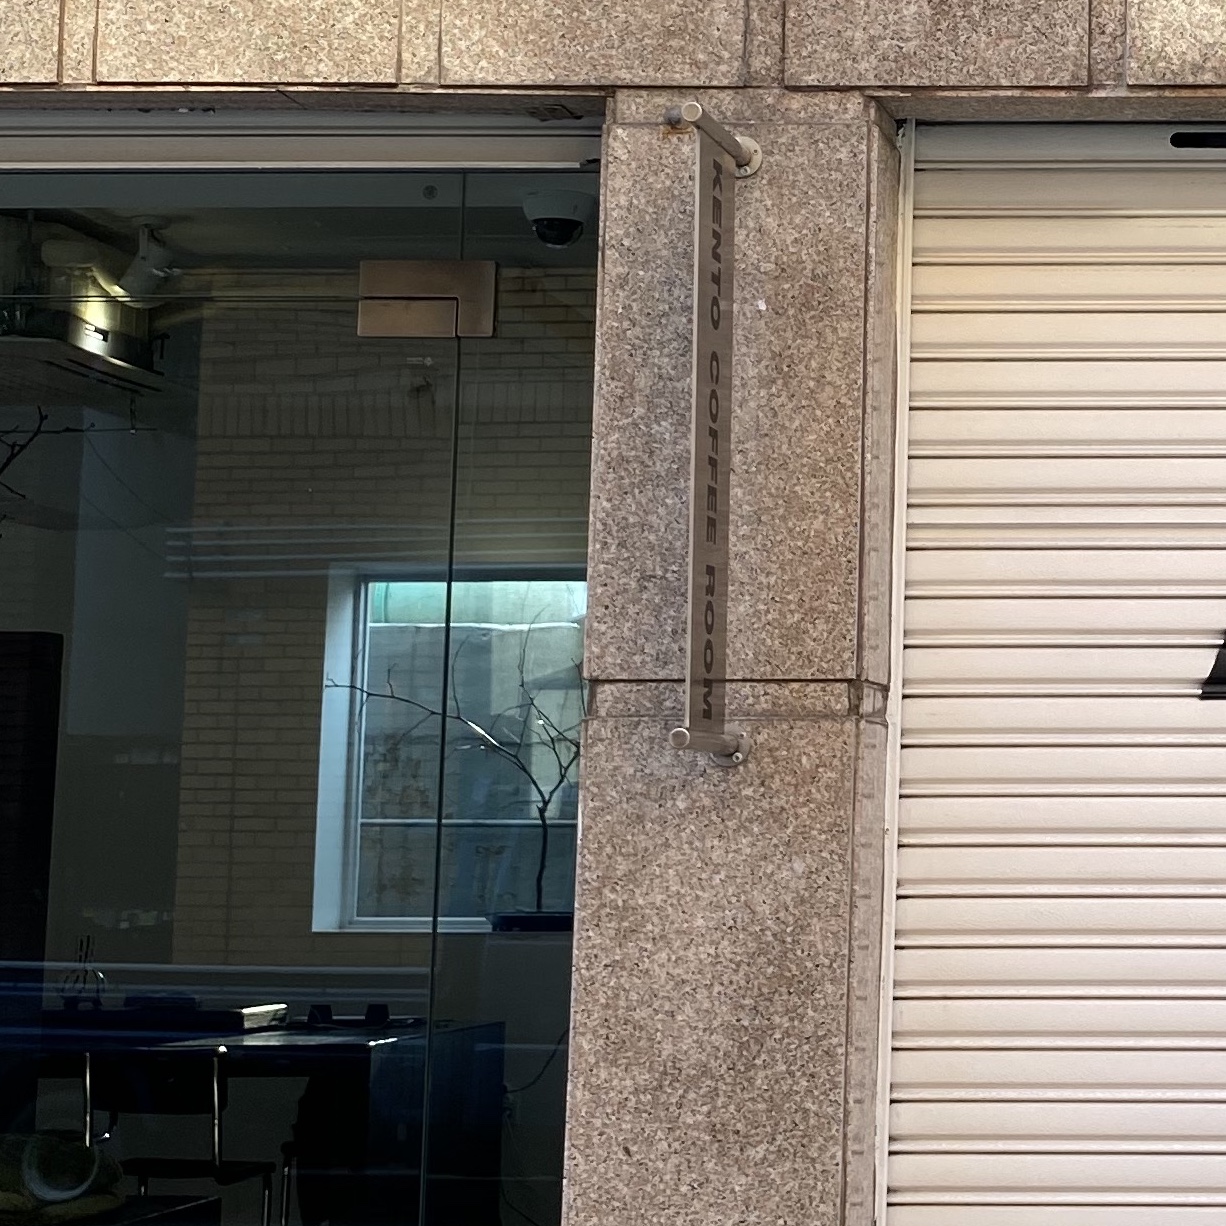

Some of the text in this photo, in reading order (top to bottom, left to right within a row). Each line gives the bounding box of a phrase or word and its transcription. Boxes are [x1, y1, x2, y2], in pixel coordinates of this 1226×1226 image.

[702, 158, 722, 720] KENTO COFFEE ROOM
